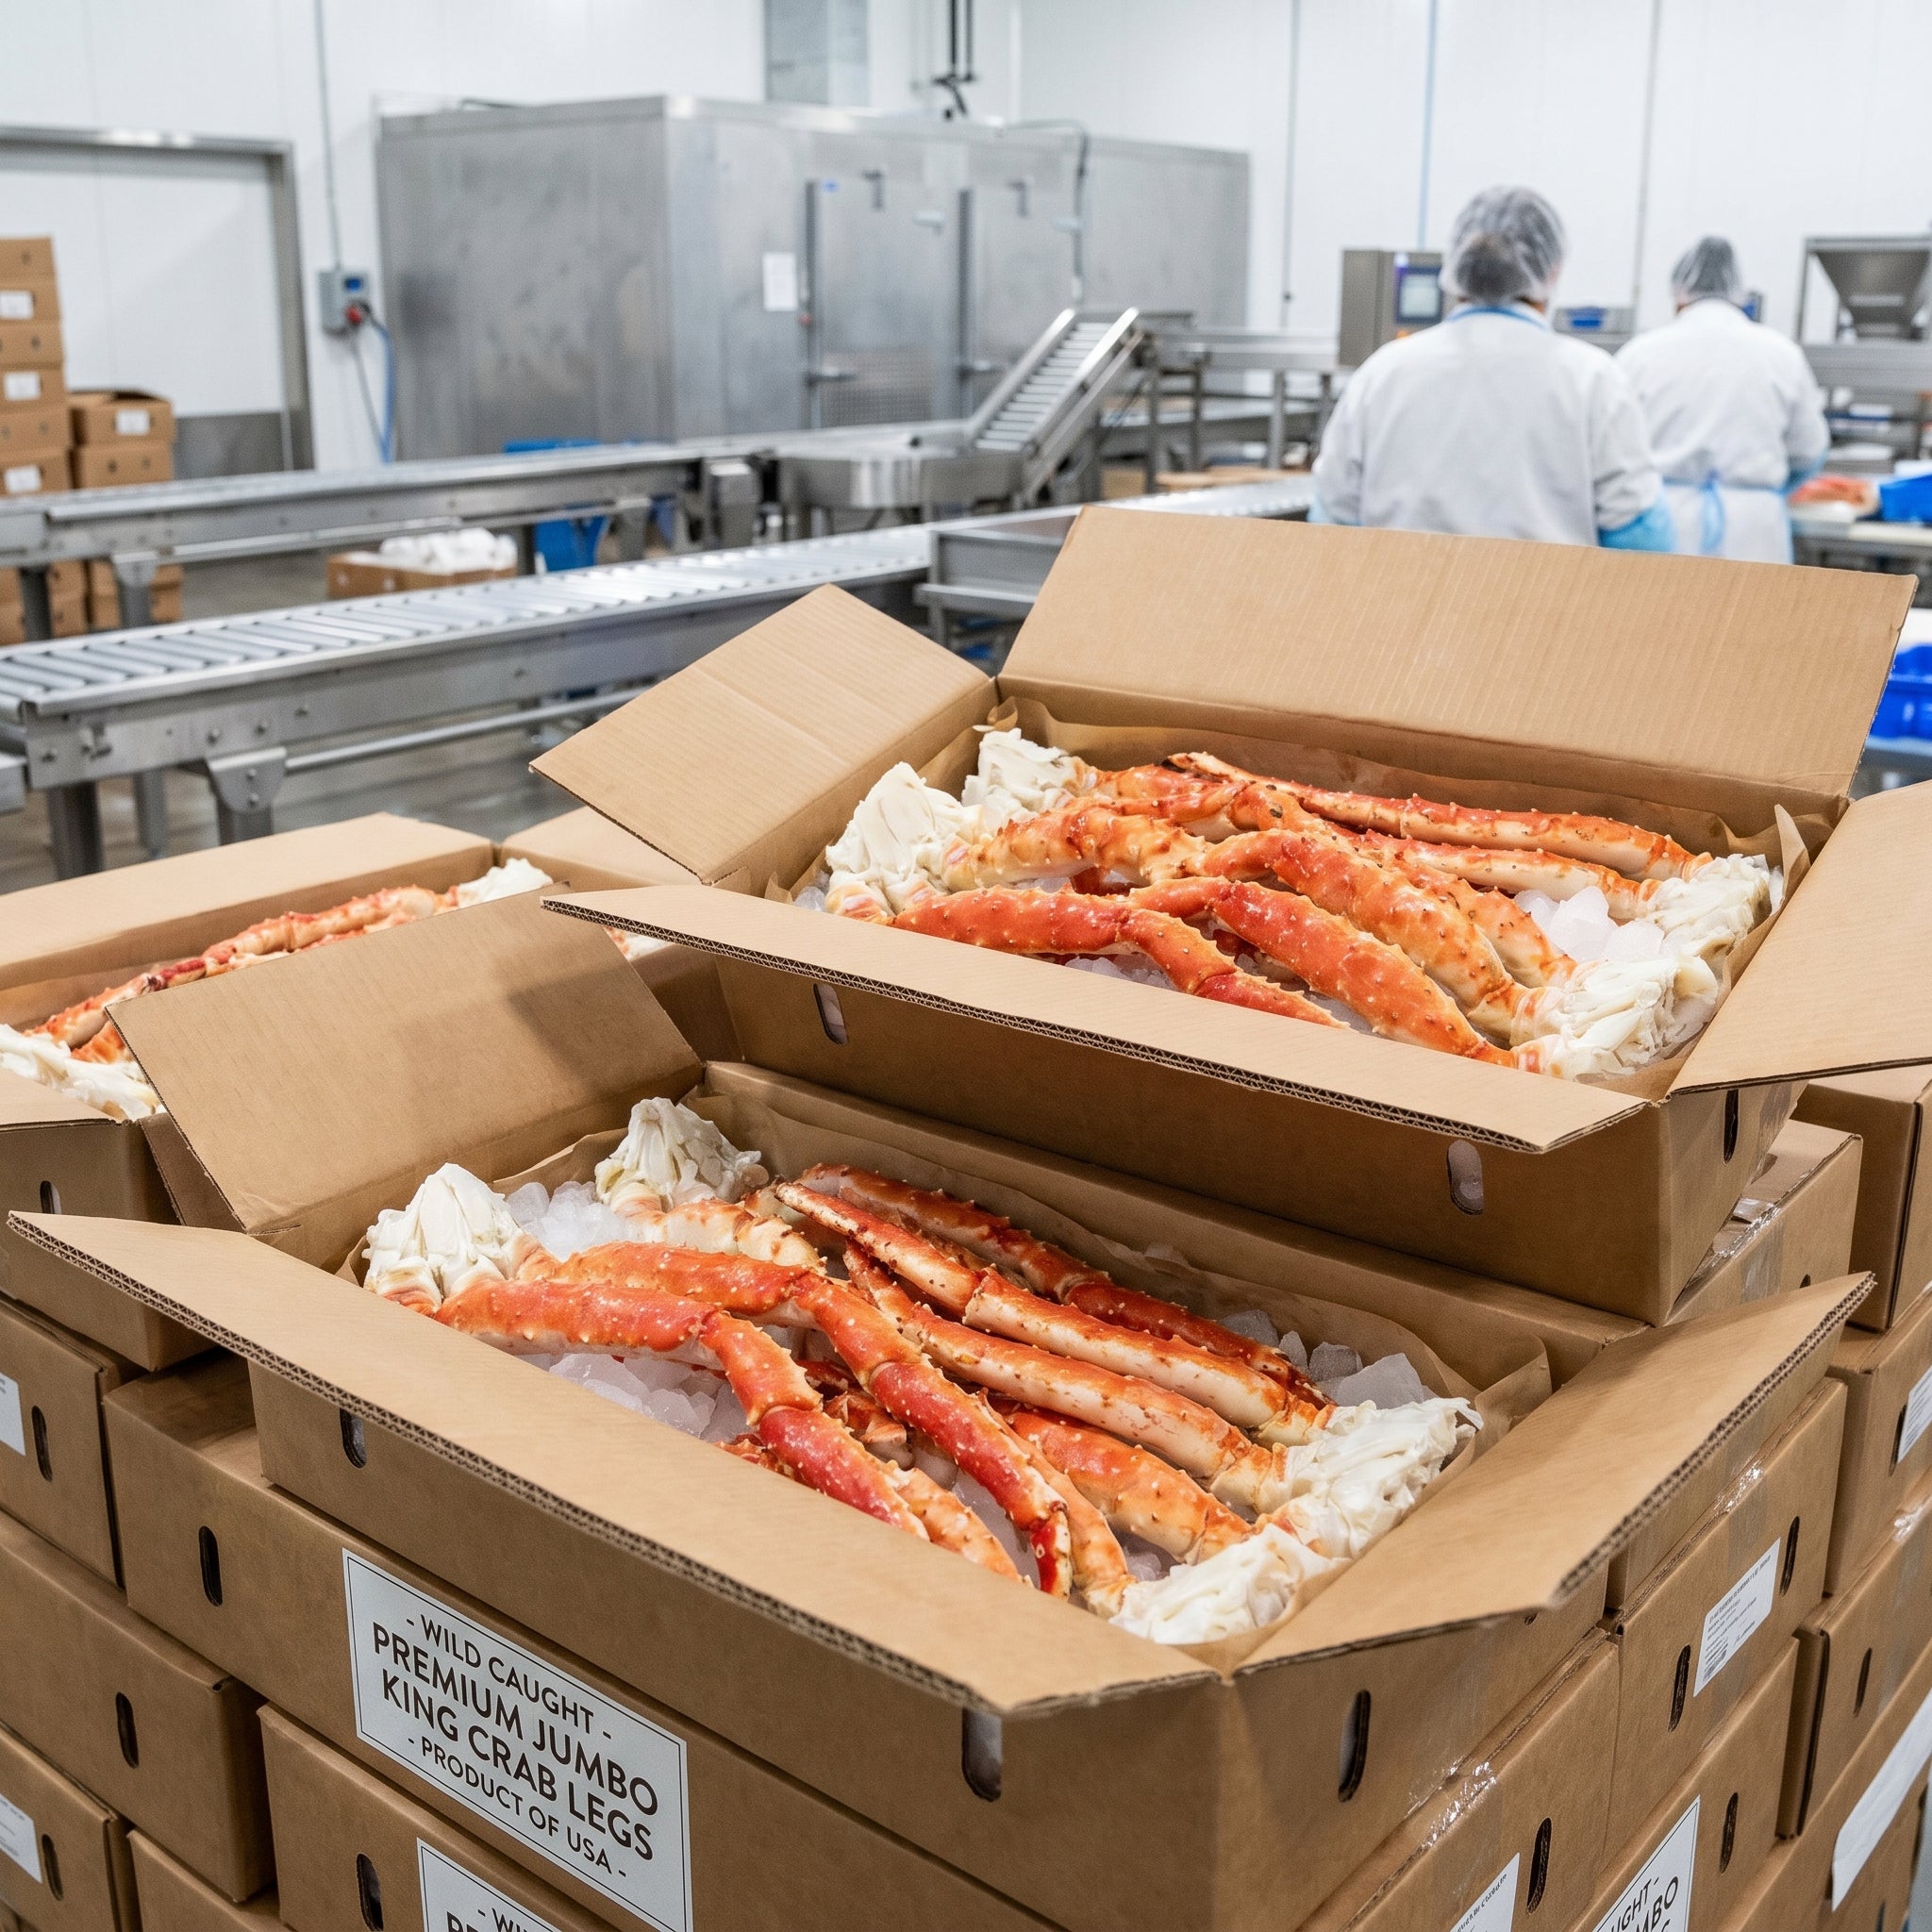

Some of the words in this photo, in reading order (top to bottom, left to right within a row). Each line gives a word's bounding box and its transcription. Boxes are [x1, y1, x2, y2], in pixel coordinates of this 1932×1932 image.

[373, 1622, 524, 1740] PREMIUM
[532, 1718, 658, 1816] JUMBO
[421, 1614, 482, 1669] WILD
[488, 1657, 594, 1735] CAUGHT
[382, 1668, 458, 1742] KING
[468, 1724, 558, 1802] CRAB
[568, 1780, 654, 1861] LEGS
[421, 1736, 524, 1816] PRODUCT
[528, 1806, 559, 1837] OF
[566, 1825, 612, 1874] USA
